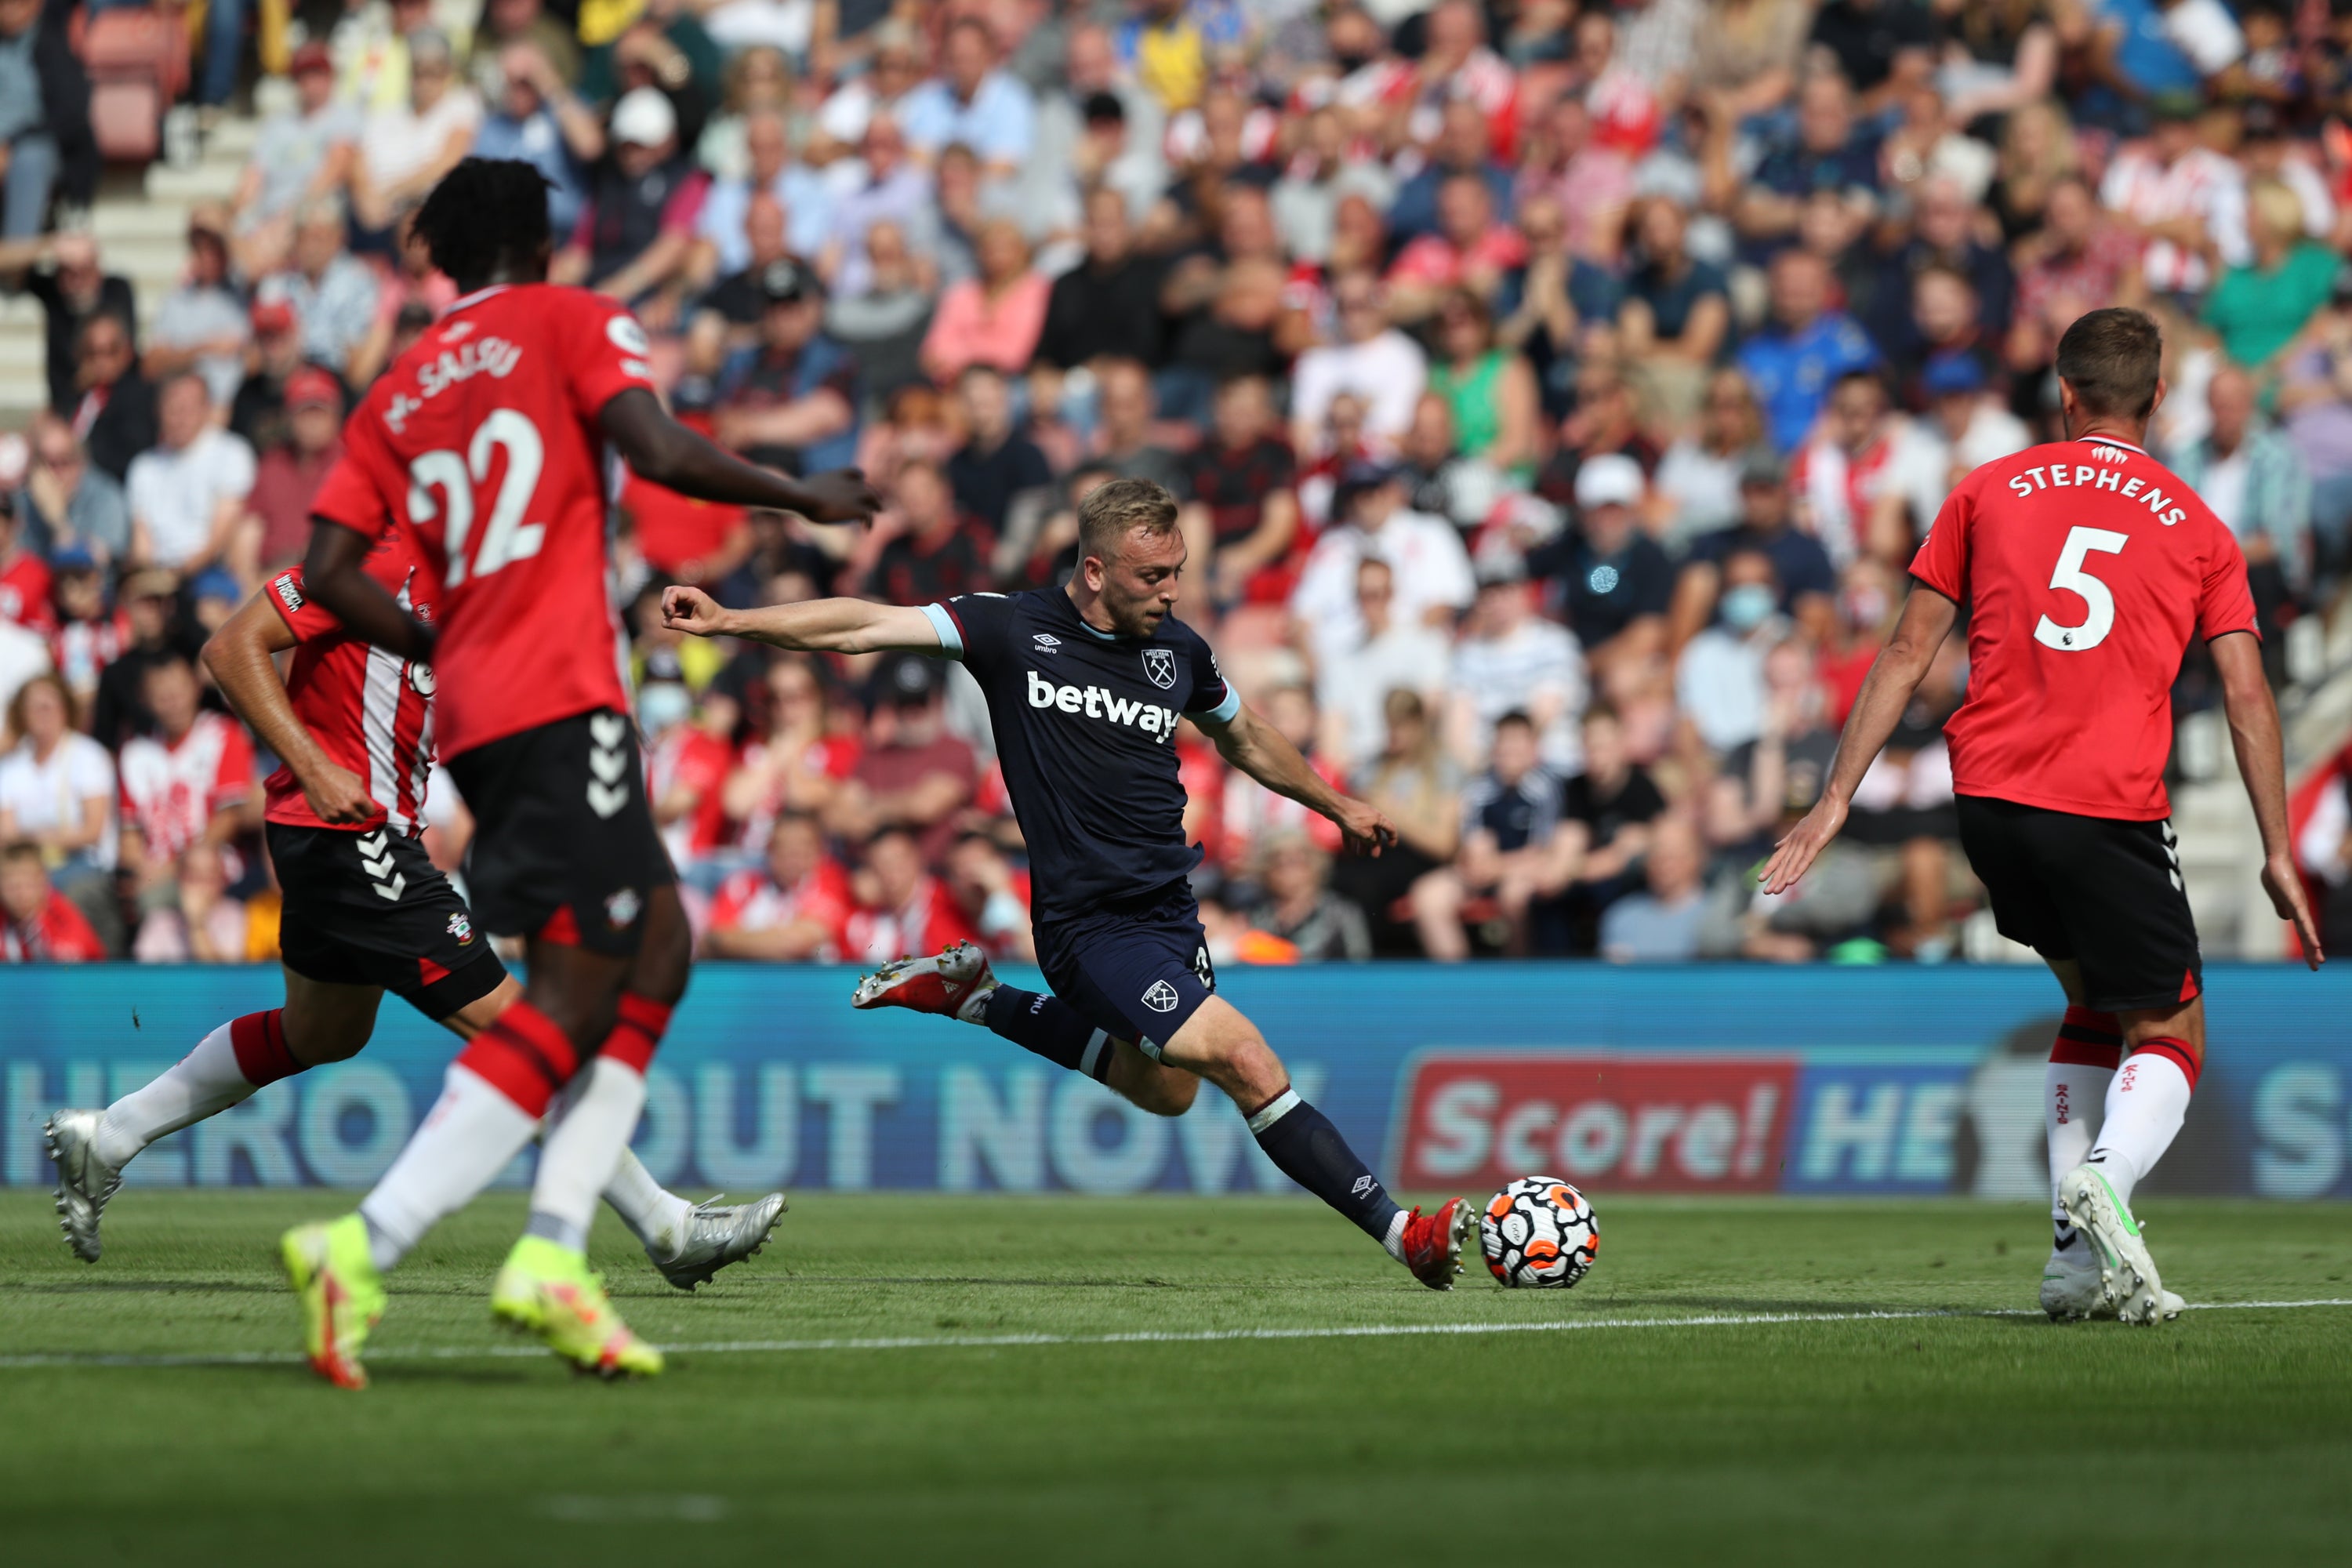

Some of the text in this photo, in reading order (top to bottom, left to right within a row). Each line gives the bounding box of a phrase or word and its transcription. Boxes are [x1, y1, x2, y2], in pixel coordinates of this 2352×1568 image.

[406, 408, 546, 590] 22
[2008, 463, 2187, 527] STEPHENS
[2032, 524, 2130, 652] 5
[1035, 644, 1058, 655] umbro
[1027, 670, 1181, 744] betway
[1417, 1077, 1780, 1179] Score!
[2056, 1084, 2069, 1124] SAINTS
[2250, 1063, 2352, 1198] S
[1359, 1182, 1378, 1200] umbro
